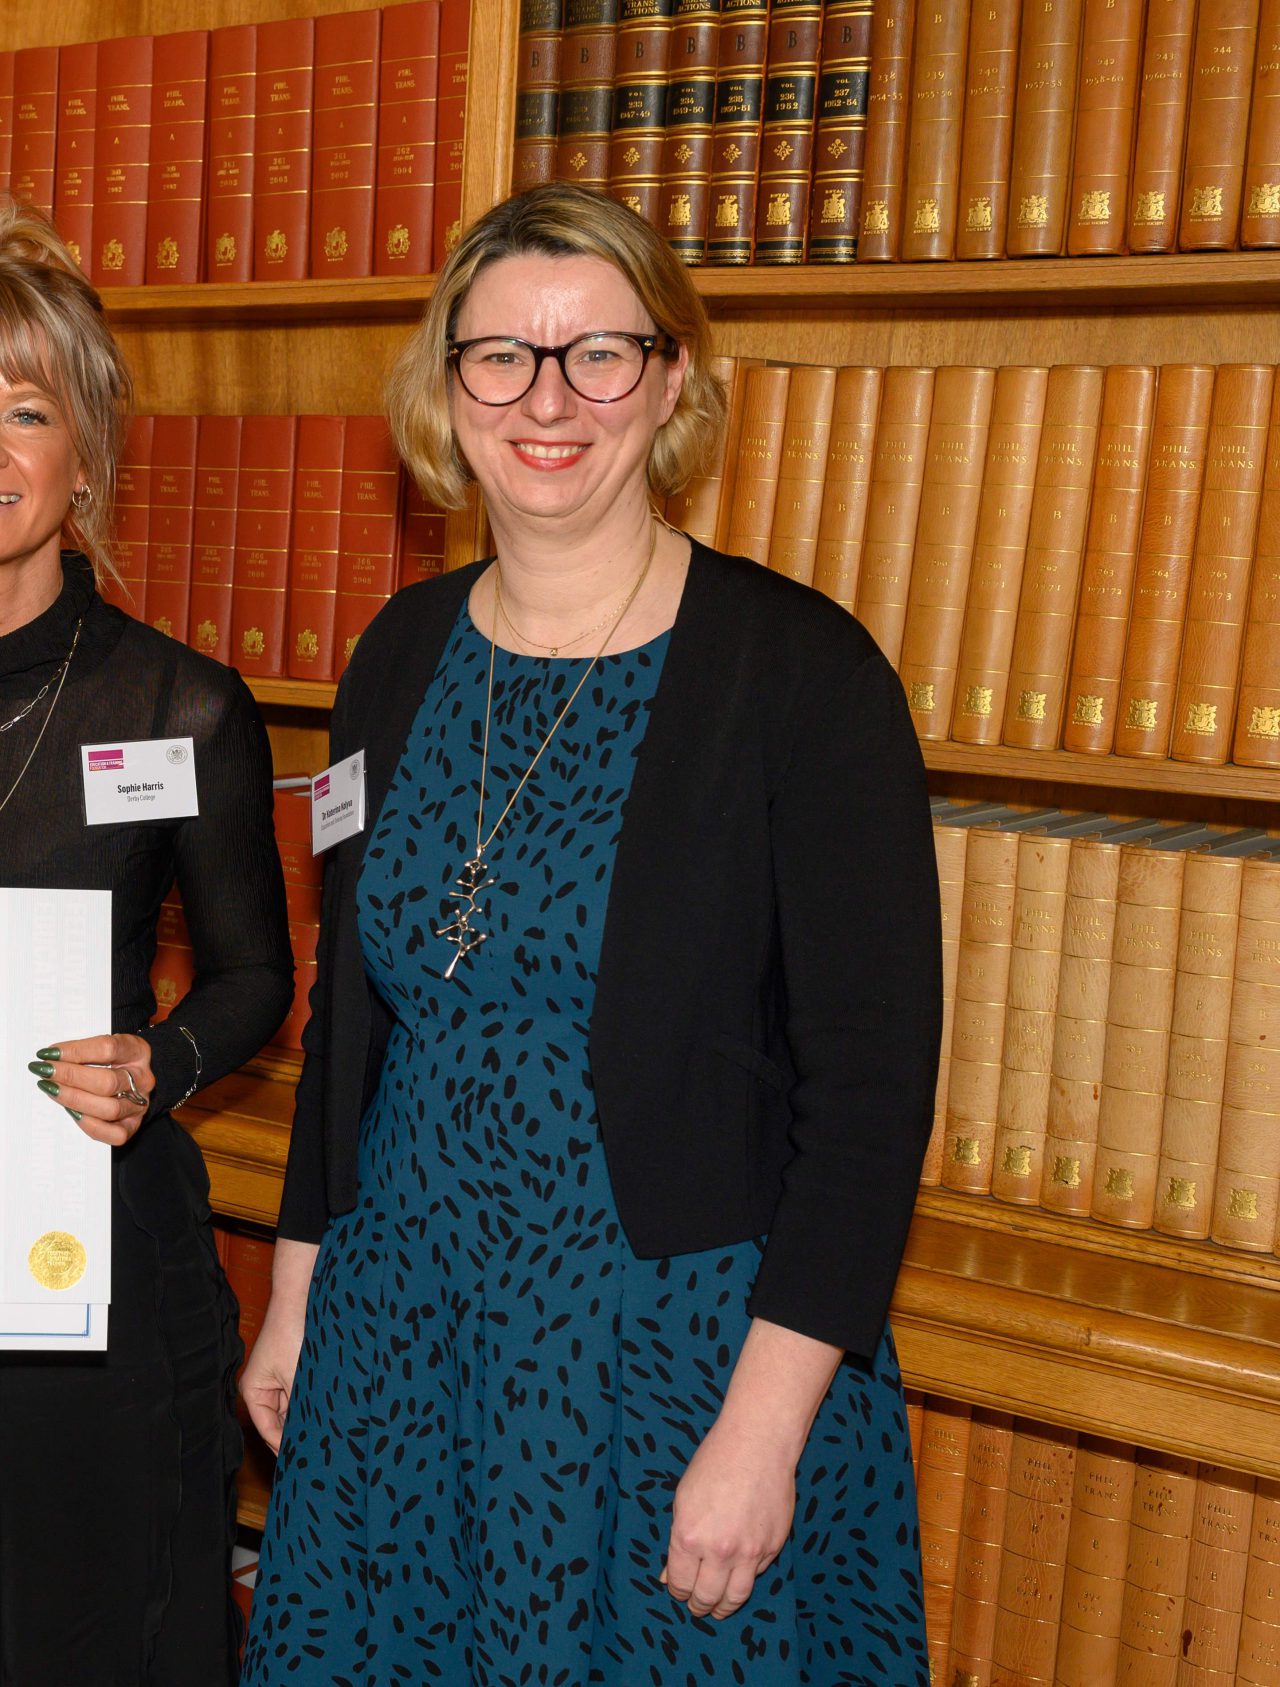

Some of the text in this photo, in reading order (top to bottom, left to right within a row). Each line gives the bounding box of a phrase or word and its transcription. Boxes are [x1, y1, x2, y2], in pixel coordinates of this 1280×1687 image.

[624, 7, 660, 16] ACTIONS
[678, 4, 710, 12] ACTIONS
[1044, 3, 1053, 12] B
[934, 14, 942, 23] B
[989, 11, 997, 20] B
[886, 18, 895, 28] B
[842, 26, 852, 43] B
[736, 34, 746, 51] B
[788, 31, 797, 48] B
[635, 41, 644, 58] B
[687, 37, 696, 54] B
[1213, 46, 1232, 54] 244
[531, 51, 540, 67] B
[581, 47, 589, 63] B
[1200, 66, 1239, 75] 1961-62
[1145, 72, 1182, 81] 1960-61
[834, 89, 850, 97] 237
[776, 102, 798, 111] 1952
[824, 98, 857, 108] 1952-54
[117, 781, 164, 794] Sophie Harris
